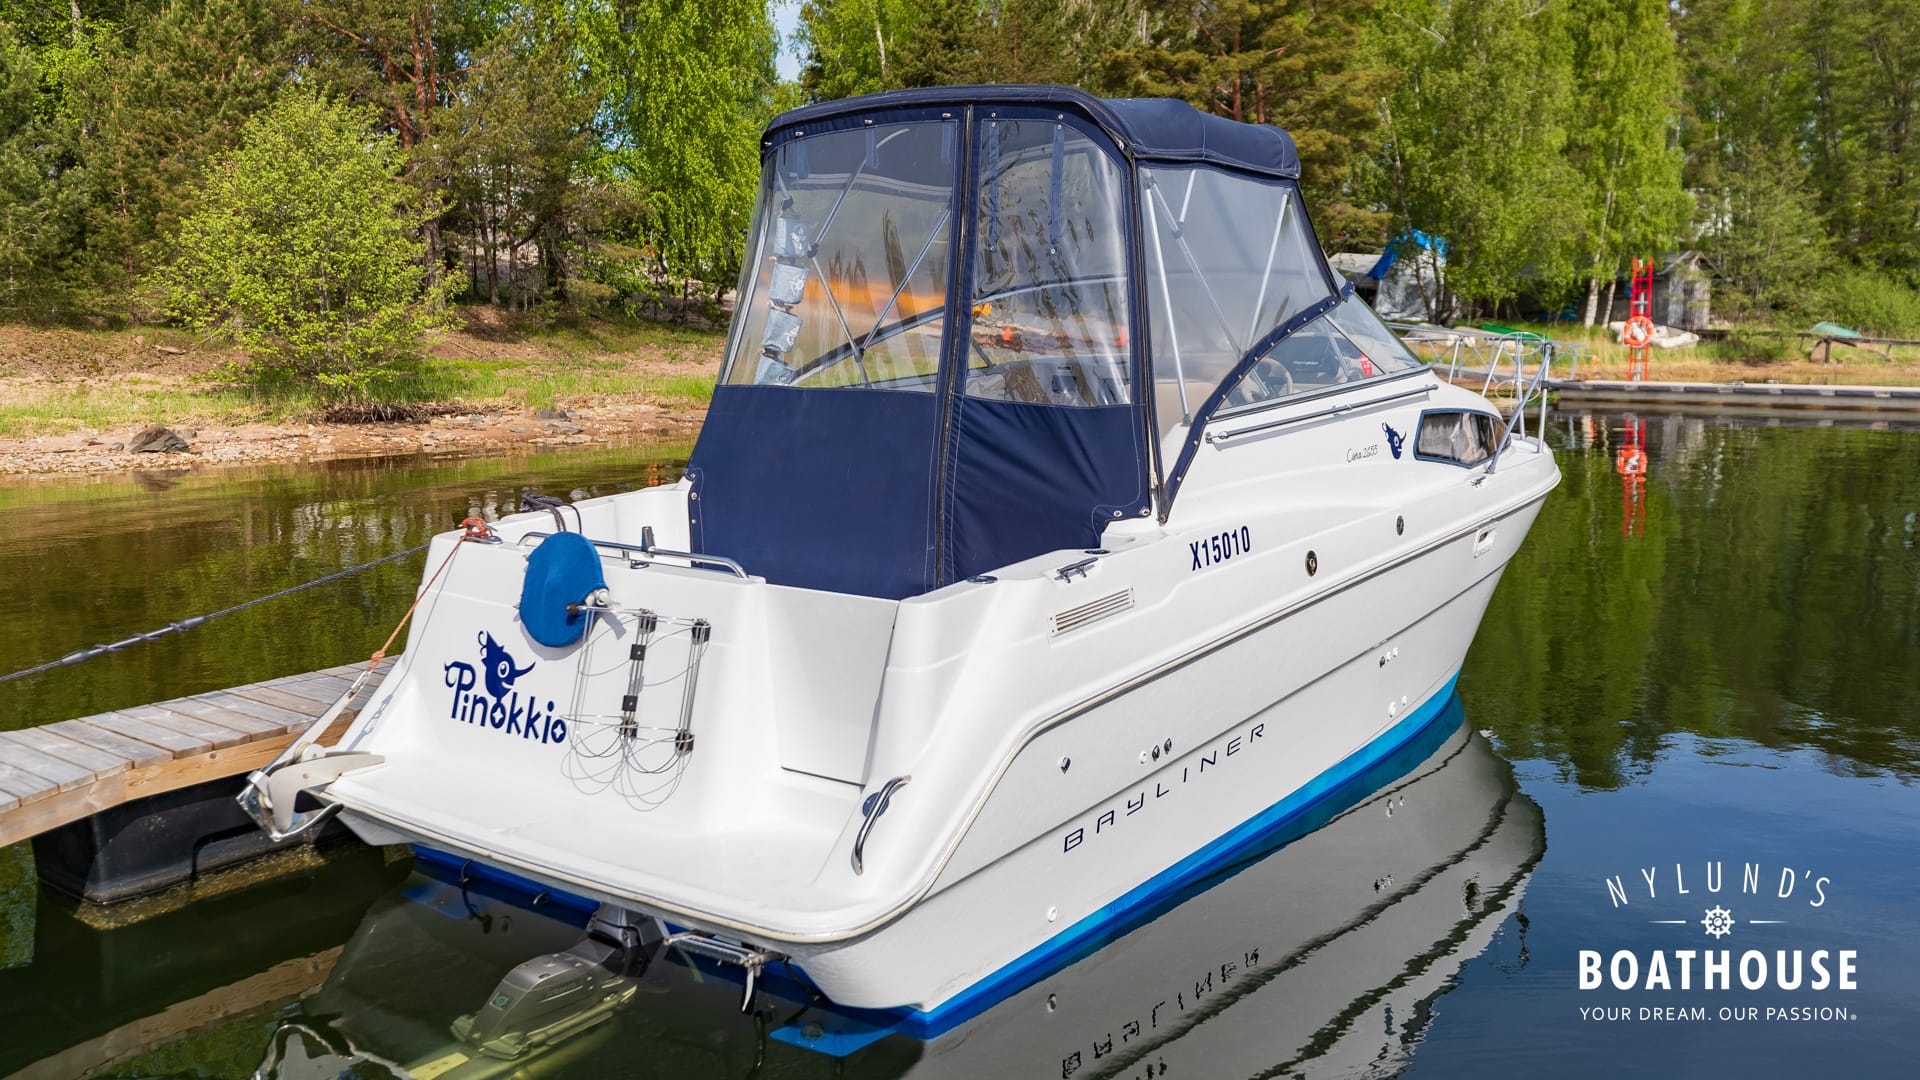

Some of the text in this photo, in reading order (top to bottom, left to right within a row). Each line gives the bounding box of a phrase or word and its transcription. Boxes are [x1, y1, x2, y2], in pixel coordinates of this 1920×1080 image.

[1189, 525, 1251, 571] X15010
[444, 660, 567, 744] Pinokkio
[1063, 723, 1265, 853] BAYLINER
